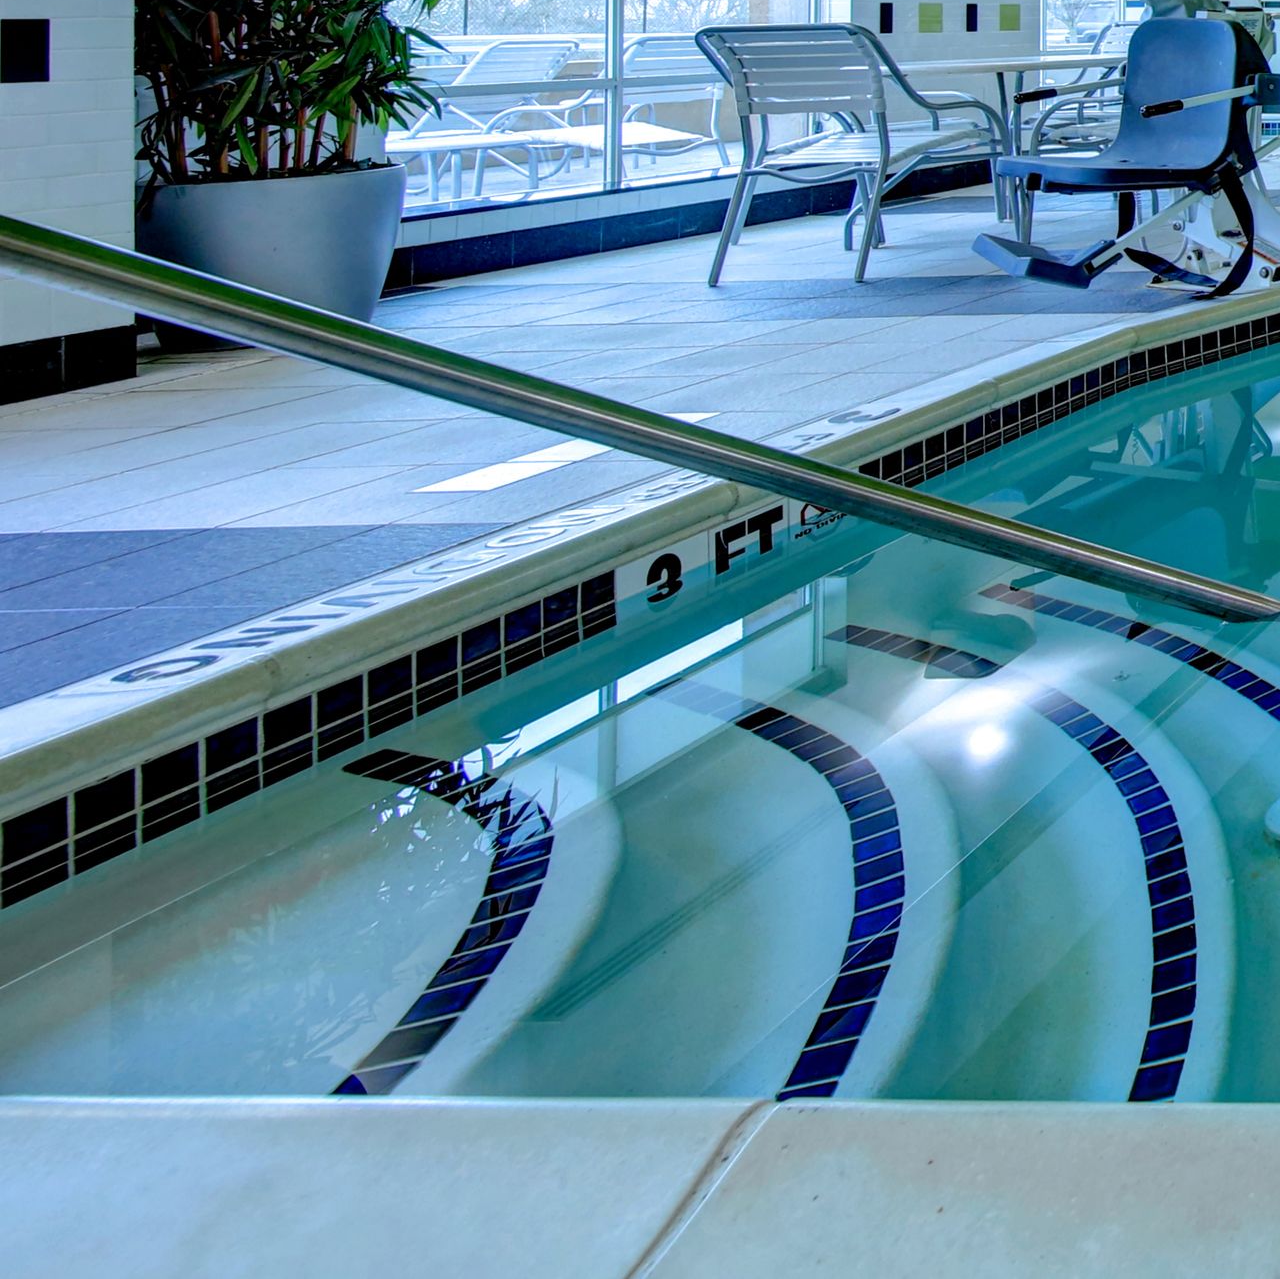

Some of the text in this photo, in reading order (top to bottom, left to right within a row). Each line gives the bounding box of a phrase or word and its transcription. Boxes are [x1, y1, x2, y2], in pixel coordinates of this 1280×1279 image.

[646, 504, 784, 603] 3 FT
[795, 528, 812, 539] NO
